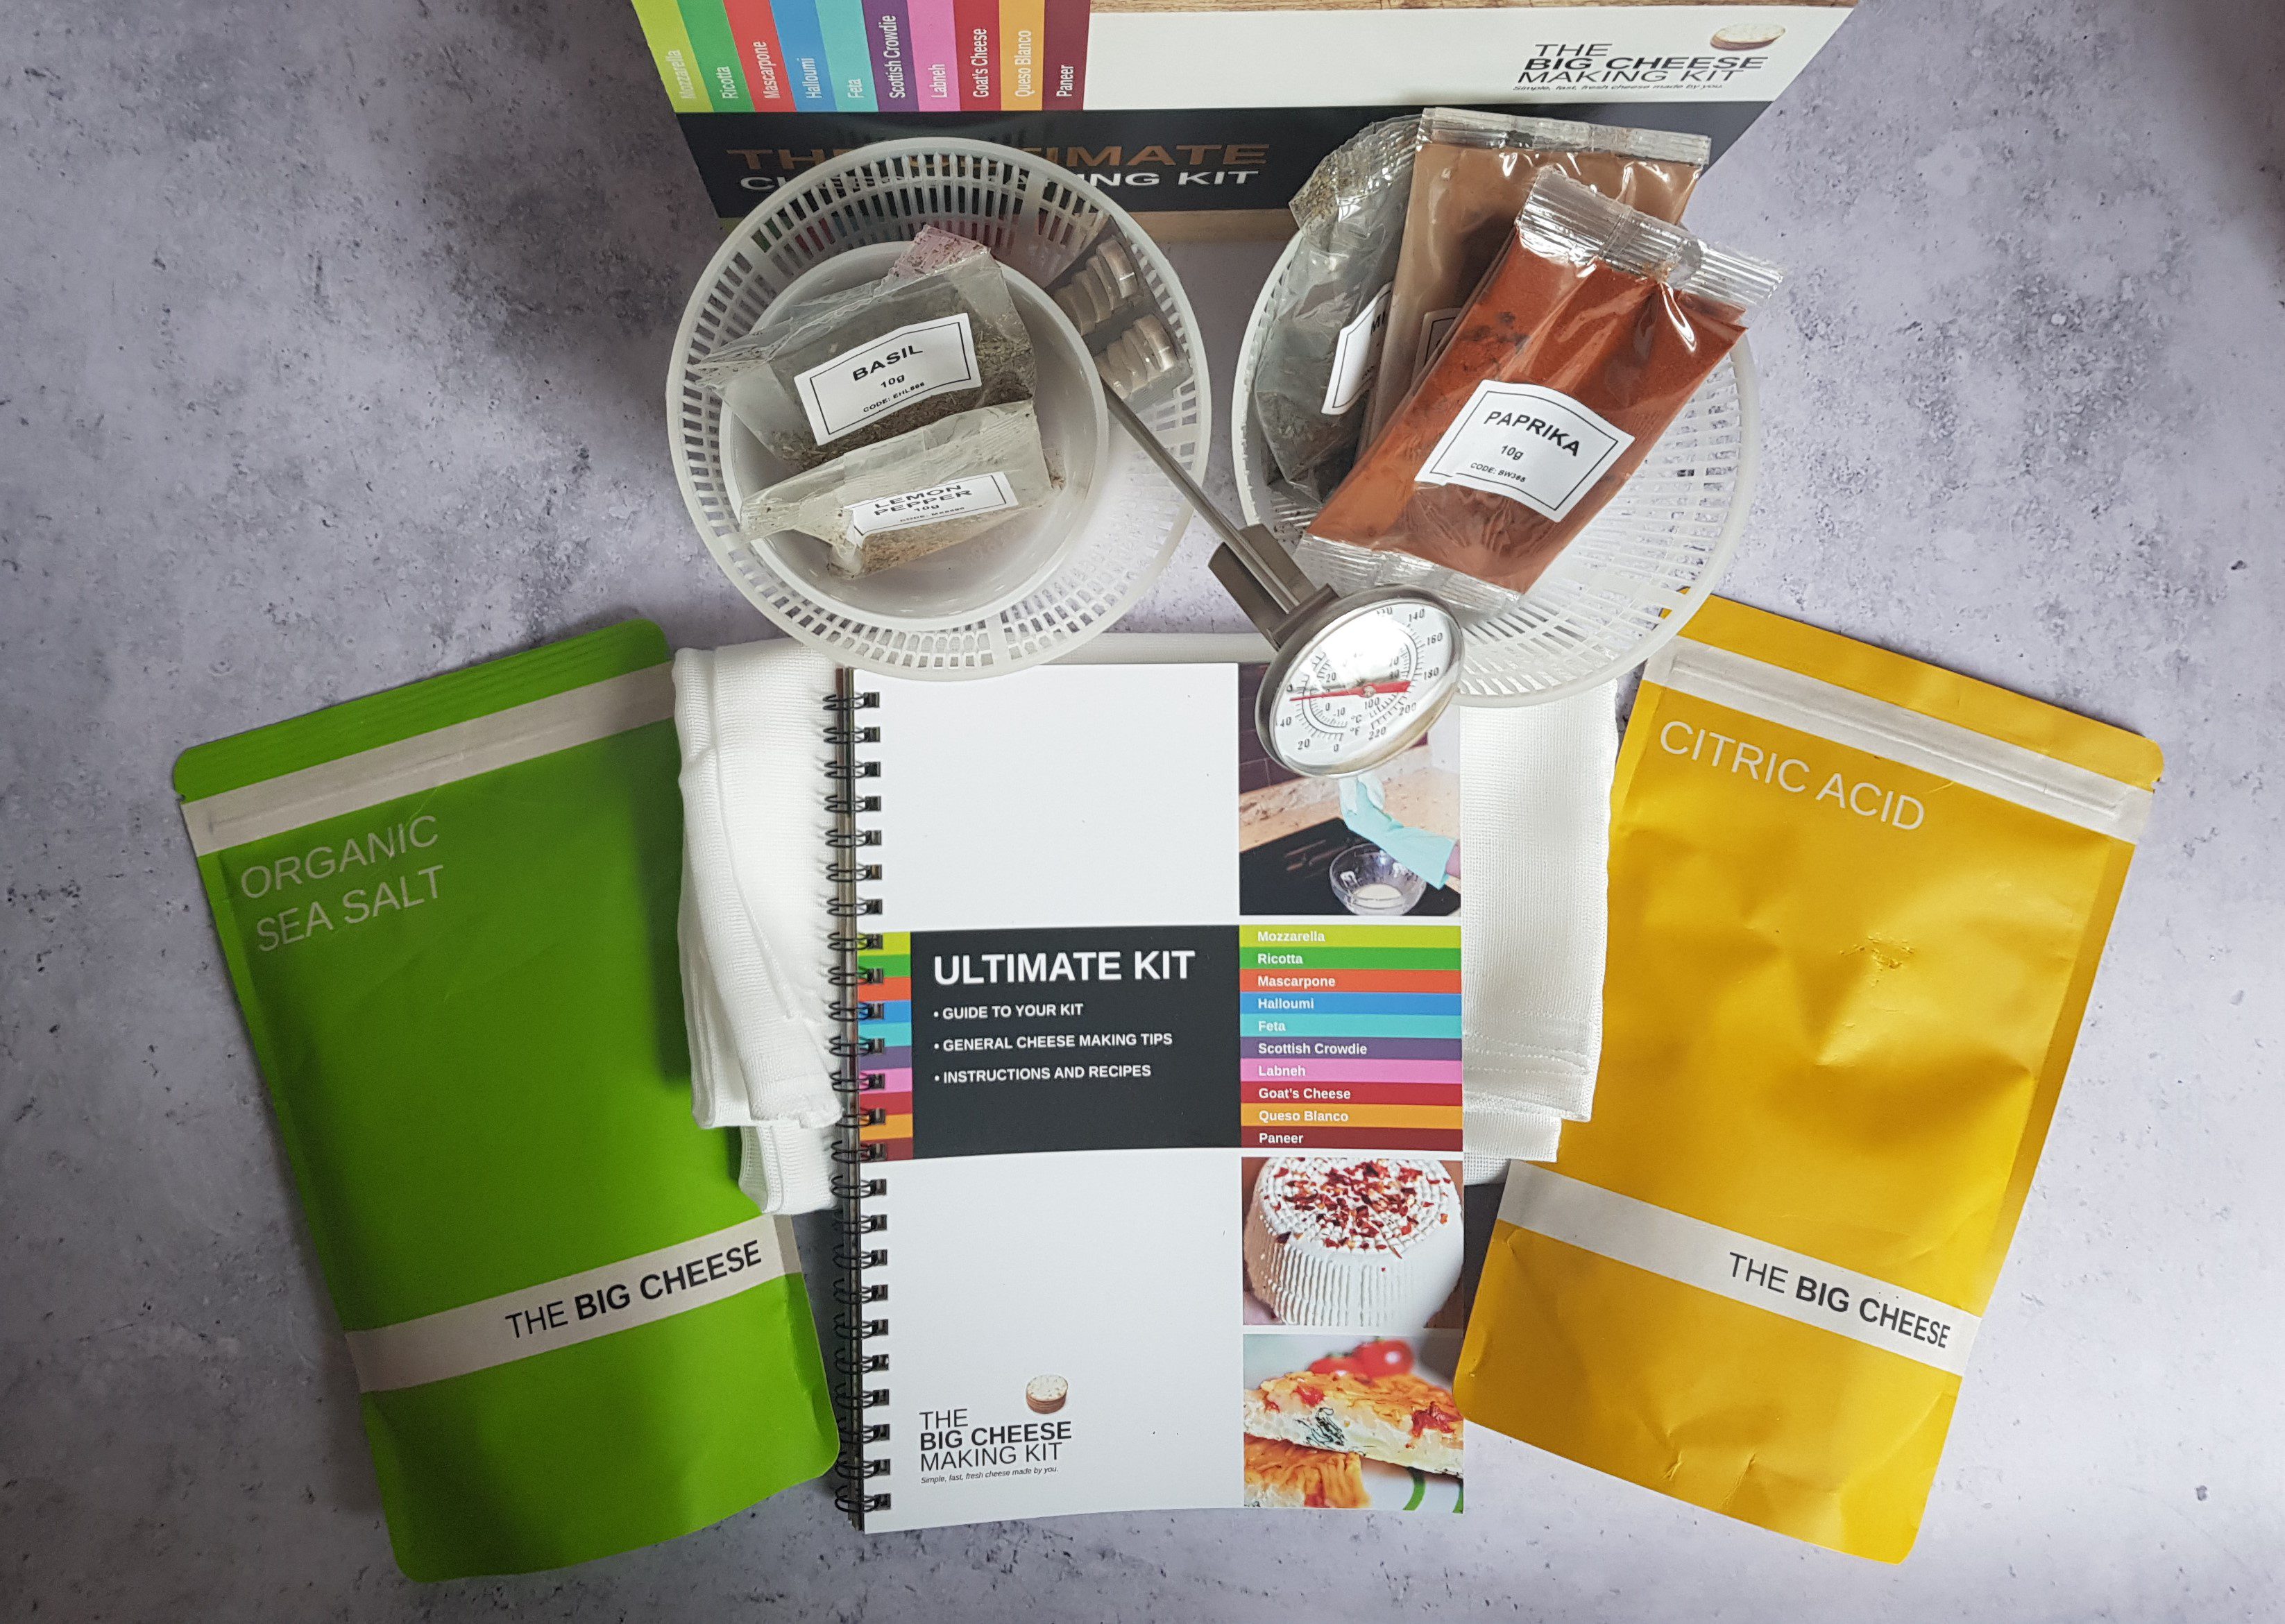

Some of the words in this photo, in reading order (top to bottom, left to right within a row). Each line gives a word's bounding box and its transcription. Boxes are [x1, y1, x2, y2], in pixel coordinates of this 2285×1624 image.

[878, 15, 901, 58] Crowdie
[971, 28, 988, 66] Cheese
[1014, 30, 1031, 65] Blanco
[1534, 43, 1613, 57] THE
[753, 41, 781, 99] Mascarpone
[1524, 58, 1592, 70] BIG
[1606, 56, 1769, 69] CHEESE
[666, 49, 696, 99] Mozzarella
[716, 66, 738, 99] Ricotta
[797, 58, 822, 99] Halloumi
[883, 61, 906, 99] Scottish
[928, 64, 947, 99] Labneh
[973, 67, 989, 98] Goat's
[1014, 68, 1035, 97] Queso
[1056, 65, 1074, 97] Paneer
[1518, 69, 1667, 83] MAKING
[1681, 69, 1744, 82] KIT
[848, 78, 865, 99] Feta
[1178, 170, 1259, 185] KIT
[852, 345, 924, 382] BASIL
[880, 374, 905, 388] 10g
[863, 397, 891, 413] CODE:
[1483, 411, 1580, 456] PAPRIKA
[1501, 445, 1524, 461] 10g
[1470, 462, 1496, 475] CODE:
[874, 485, 962, 508] LEMON
[874, 490, 973, 515] PEPPER
[1409, 608, 1425, 622] 140
[1427, 632, 1443, 646] 160
[1364, 696, 1380, 710] 100
[1399, 702, 1416, 716] 200
[1368, 726, 1386, 741] 220
[1298, 738, 1310, 750] 20
[1660, 721, 1810, 793] CITRIC
[1815, 773, 1925, 830] ACID
[241, 814, 439, 899] ORGANIC
[256, 901, 334, 952] SEA
[342, 864, 444, 925] SALT
[1257, 930, 1325, 942] Mozzarella
[934, 951, 1121, 985] ULTIMATE
[1135, 950, 1196, 980] KIT
[1257, 952, 1303, 965] Ricotta
[1257, 975, 1336, 989] Mascarpone
[942, 1006, 988, 1020] GUIDE
[992, 1005, 1012, 1018] TO
[1015, 1005, 1056, 1017] YOUR
[1060, 1003, 1084, 1016] KIT
[1257, 998, 1314, 1009] Halloumi
[1258, 1020, 1286, 1032] Feta
[943, 1037, 1013, 1052] GENERAL
[1017, 1034, 1076, 1049] CHEESE
[1079, 1033, 1137, 1048] MAKING
[1141, 1032, 1173, 1046] TIPS
[1258, 1043, 1311, 1054] Scottish
[1314, 1043, 1368, 1055] Crowdie
[944, 1067, 1051, 1084] INSTRUCTIONS
[1054, 1066, 1085, 1079] AND
[1089, 1064, 1152, 1078] RECIPES
[1258, 1065, 1306, 1077] Labneh
[1258, 1087, 1300, 1100] Goat's
[1303, 1087, 1351, 1100] Cheese
[1259, 1110, 1300, 1123] Queso
[1304, 1110, 1349, 1122] Blanco
[1259, 1132, 1303, 1144] Paneer
[504, 1300, 568, 1339] THE
[574, 1283, 631, 1320] BIG
[639, 1239, 763, 1300] CHEESE
[1729, 1251, 1789, 1294] THE
[1795, 1275, 1850, 1313] BIG
[1859, 1297, 1951, 1349] CHEESE
[919, 1408, 969, 1430] THE
[920, 1430, 962, 1451] BIG
[971, 1421, 1072, 1446] CHEESE
[921, 1446, 1017, 1472] MAKING
[1026, 1442, 1063, 1462] KIT
[921, 1476, 946, 1485] Simple,
[1012, 1468, 1032, 1476] made
[1034, 1467, 1042, 1475] by
[1044, 1467, 1059, 1475] you.
